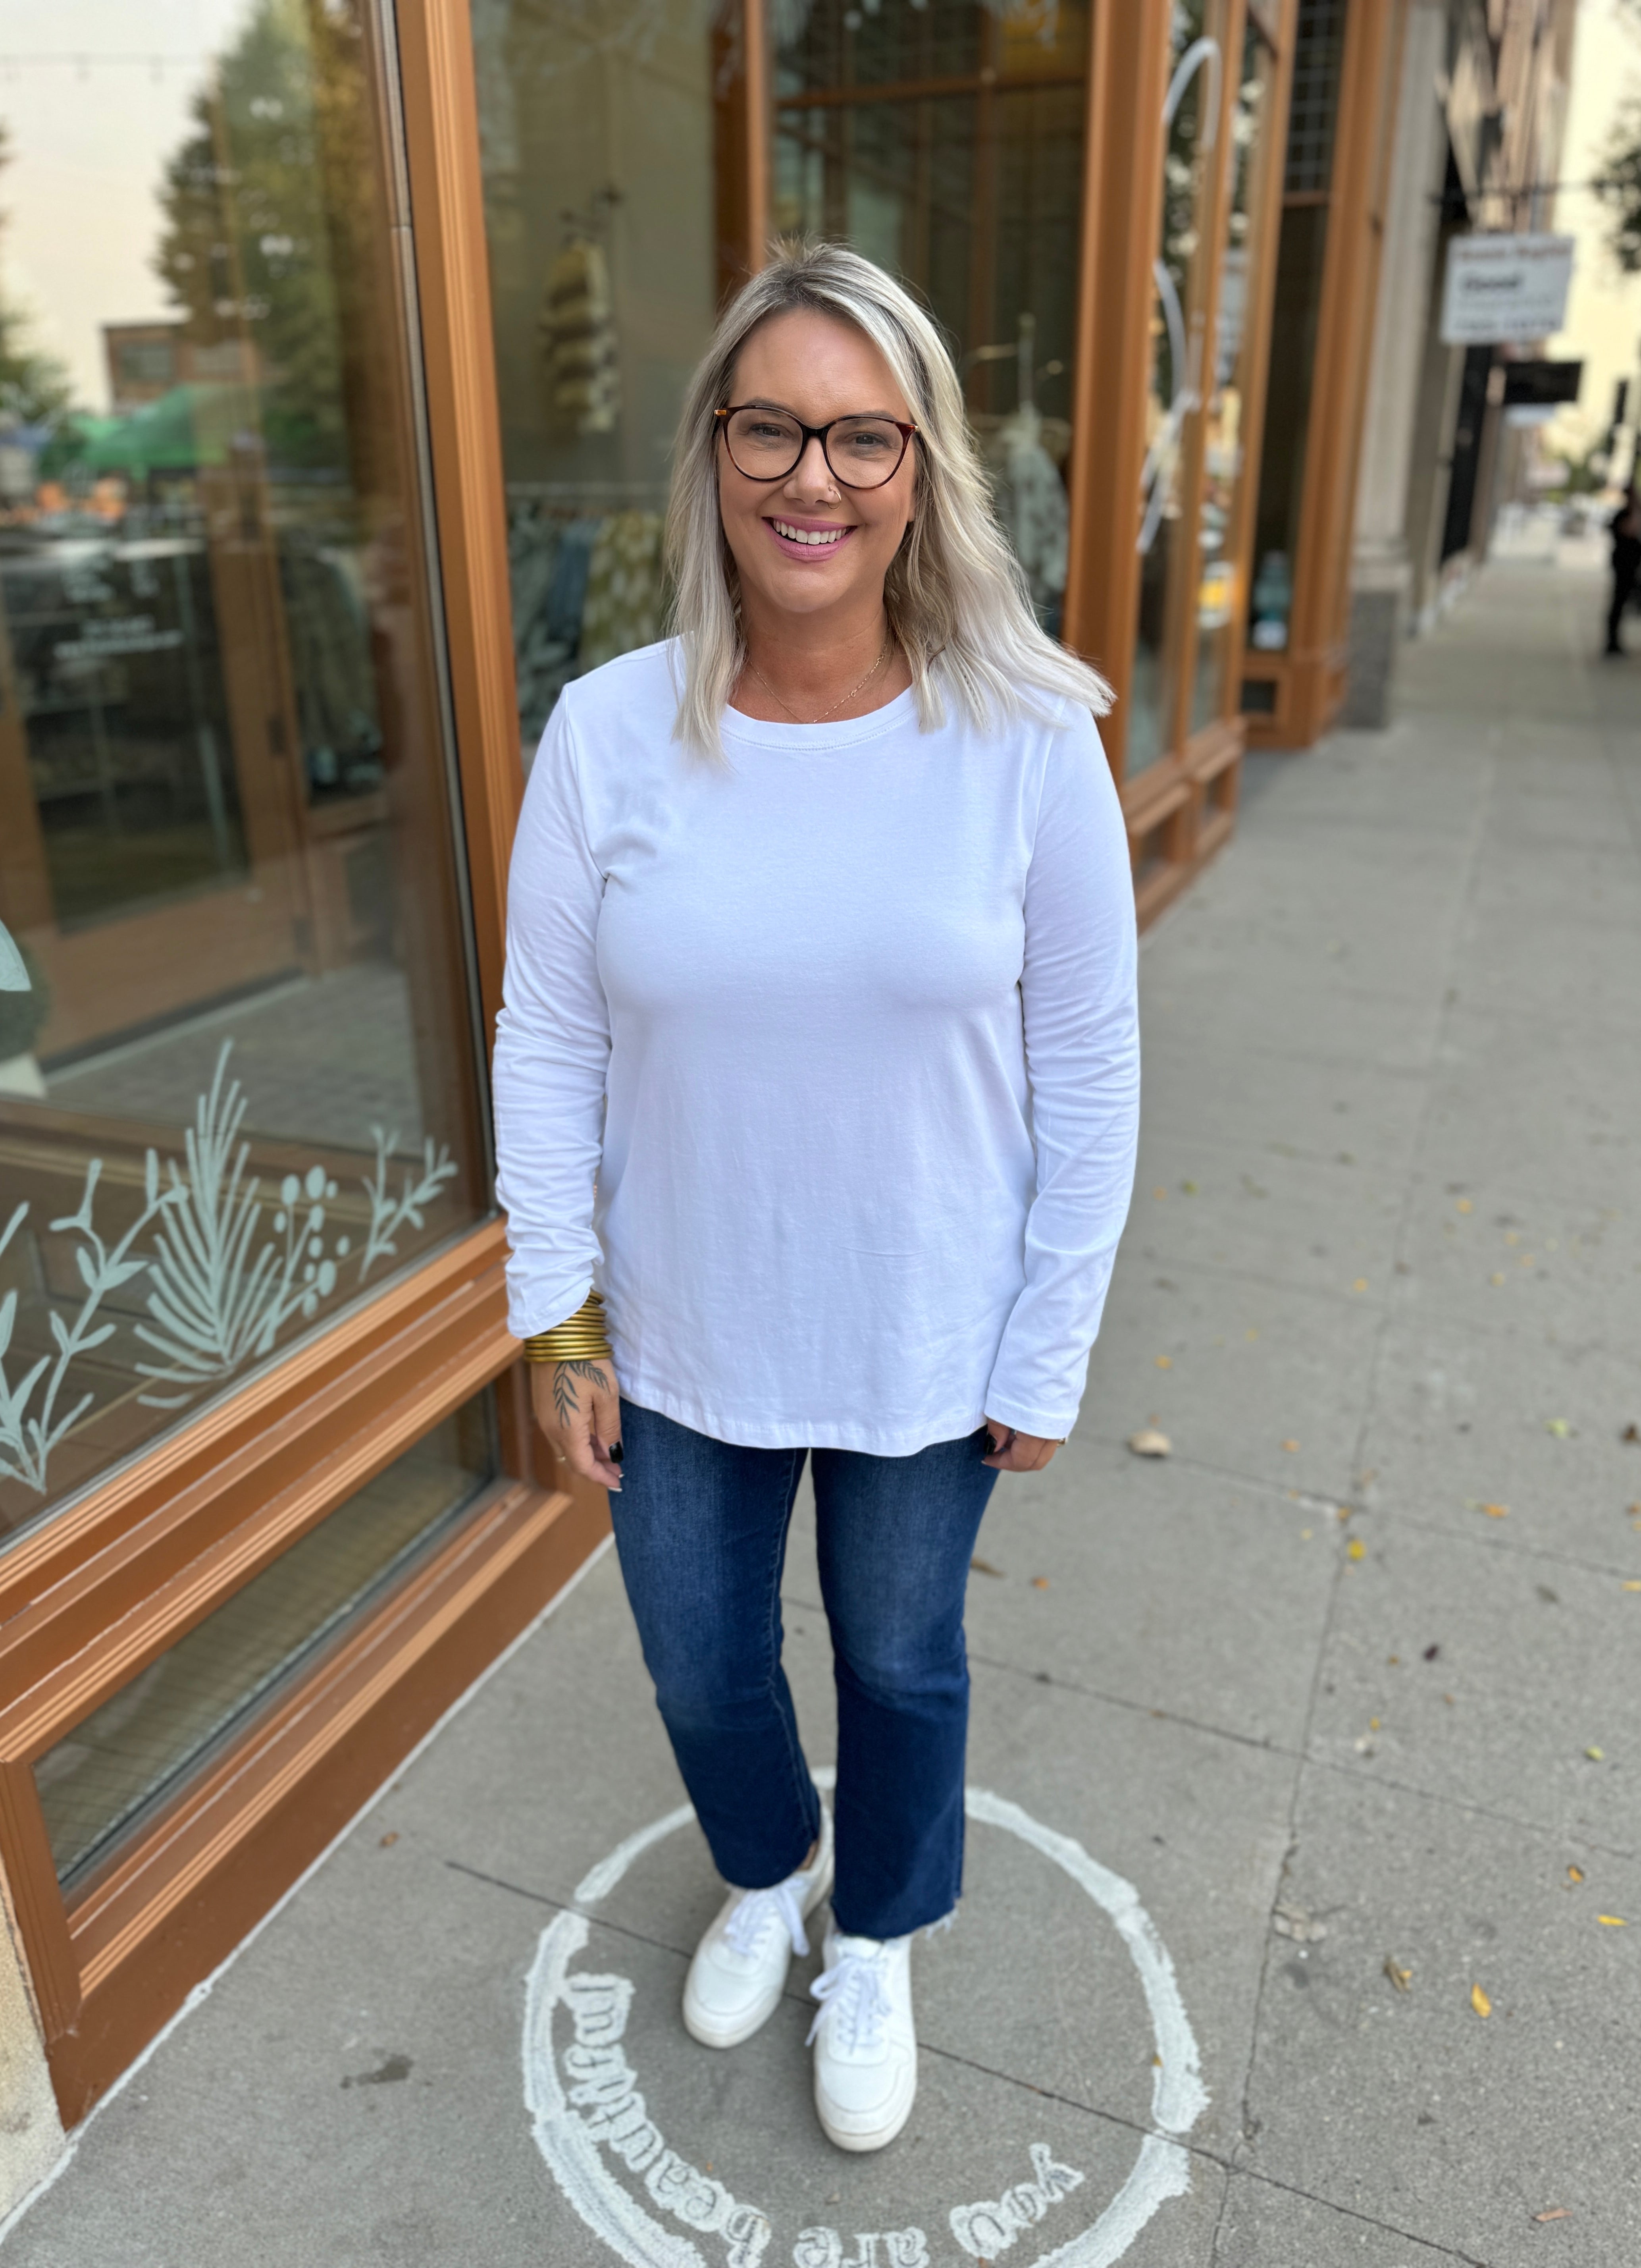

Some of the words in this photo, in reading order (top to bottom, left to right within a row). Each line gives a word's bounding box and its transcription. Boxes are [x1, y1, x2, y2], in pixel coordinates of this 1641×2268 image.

[563, 1973, 772, 2268] beautiful
[793, 2226, 930, 2268] are
[950, 2143, 1084, 2260] you
